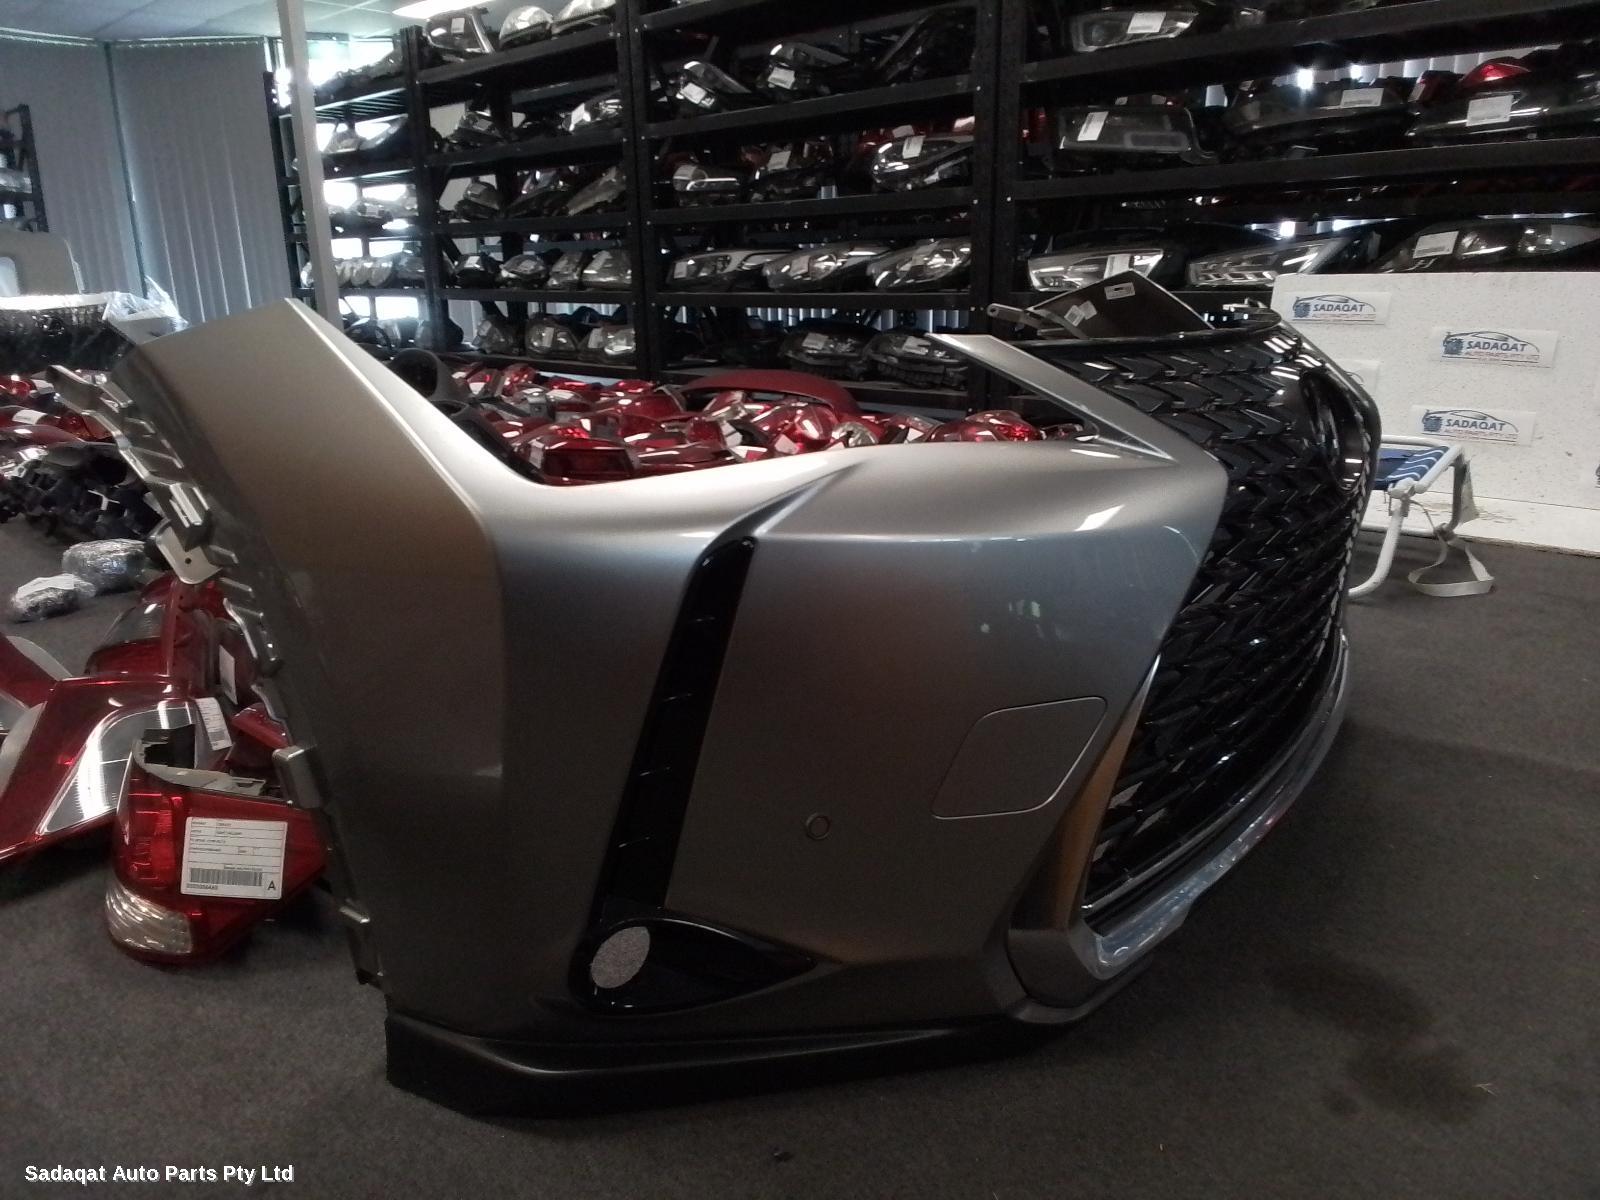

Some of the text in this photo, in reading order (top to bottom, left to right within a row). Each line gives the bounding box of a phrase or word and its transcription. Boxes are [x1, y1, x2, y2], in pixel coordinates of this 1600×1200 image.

[1313, 304, 1365, 312] SADAQAT
[1466, 341, 1528, 352] SADAQAT
[1446, 419, 1506, 431] SADAQAT
[267, 880, 277, 891] A
